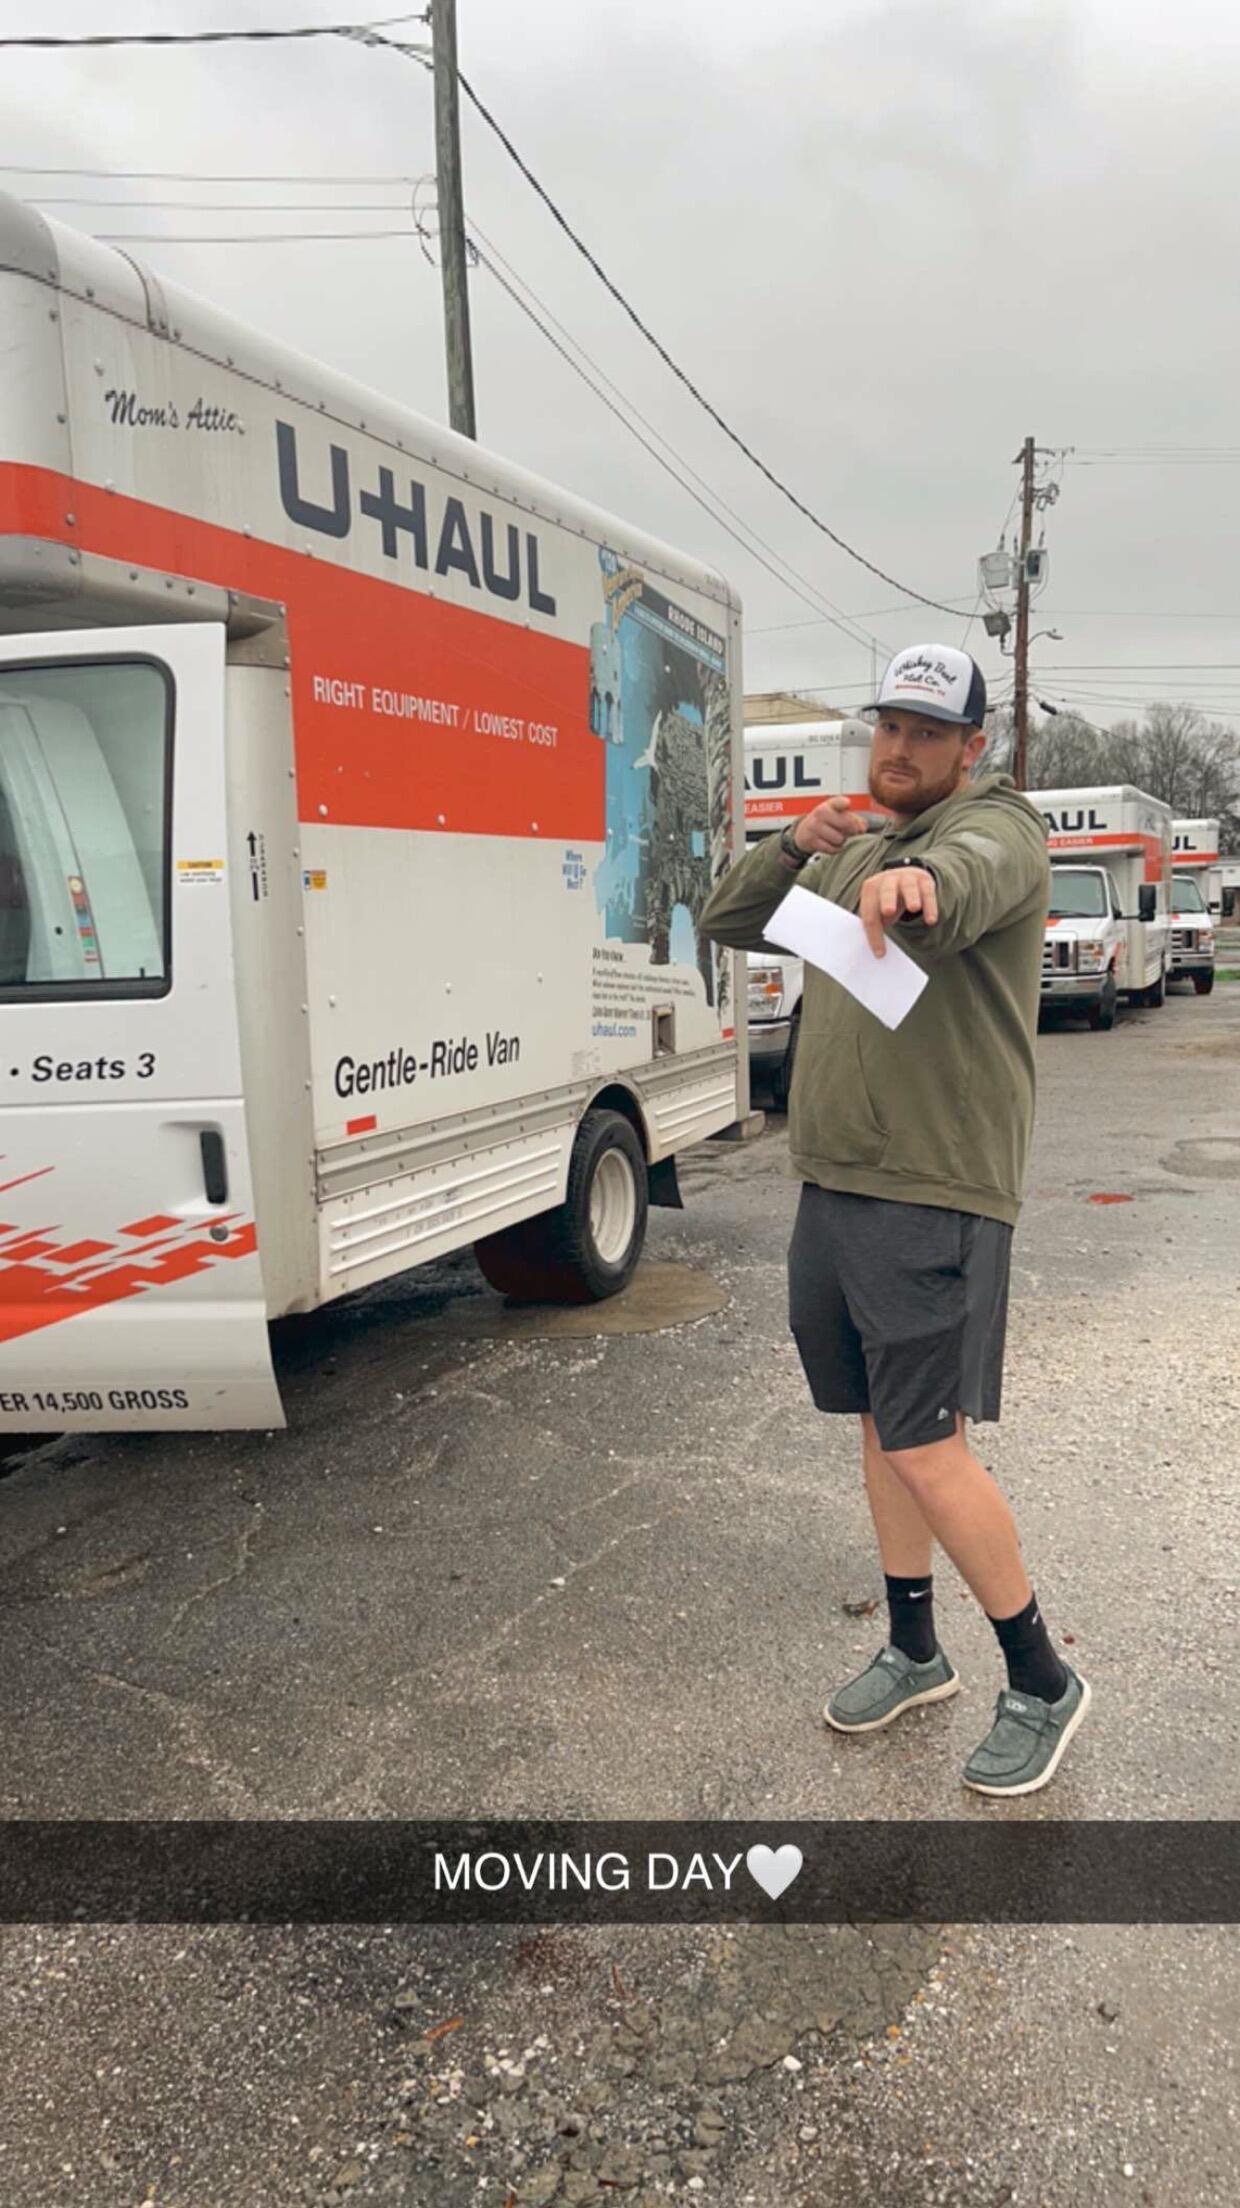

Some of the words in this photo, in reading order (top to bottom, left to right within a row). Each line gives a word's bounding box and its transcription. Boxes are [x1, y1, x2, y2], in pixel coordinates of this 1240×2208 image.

[105, 390, 179, 428] Mom's
[186, 397, 237, 431] Attic
[313, 675, 366, 709] RIGHT
[372, 688, 460, 728] EQUIPMENT
[474, 711, 526, 741] LOWEST
[528, 721, 559, 747] COST
[32, 1055, 125, 1082] Seats
[136, 1052, 156, 1079] 3
[334, 1036, 479, 1098] Gentle-Ride
[486, 1031, 520, 1067] Van
[33, 1391, 103, 1413] 14,500
[108, 1389, 189, 1410] GROSS
